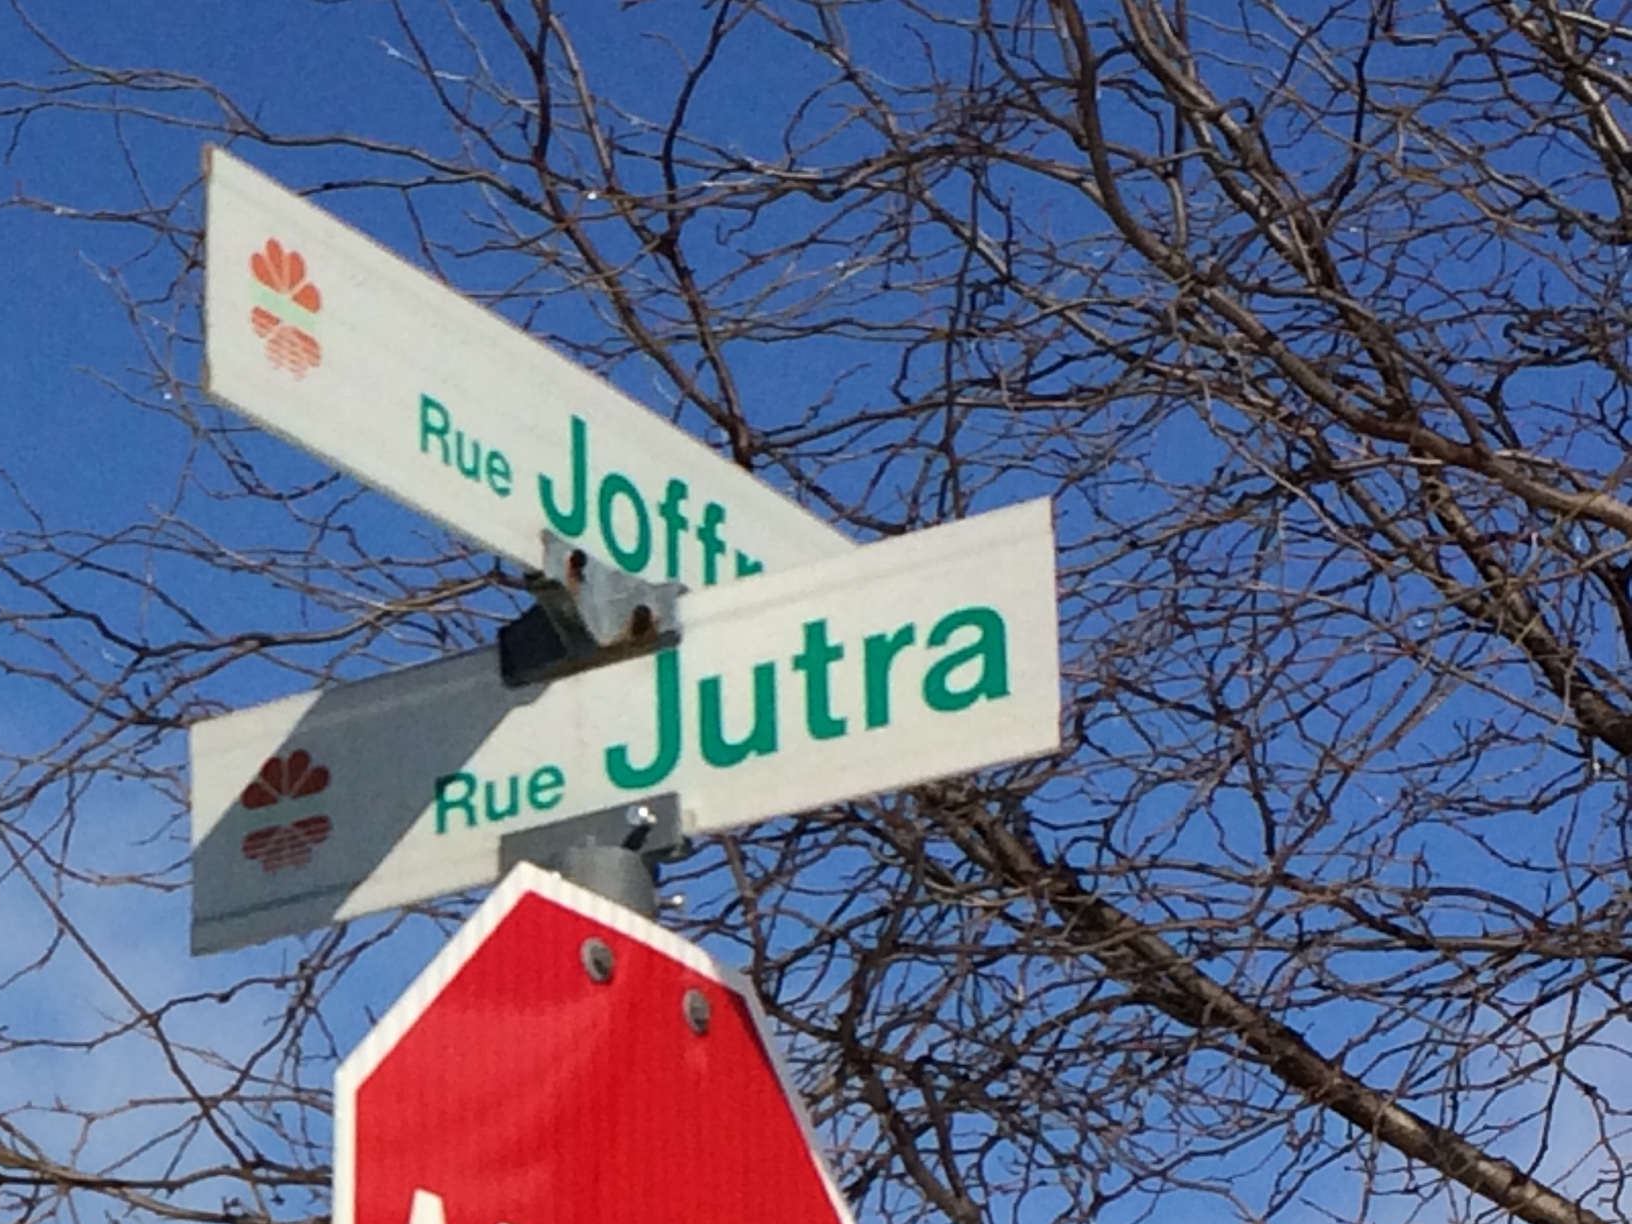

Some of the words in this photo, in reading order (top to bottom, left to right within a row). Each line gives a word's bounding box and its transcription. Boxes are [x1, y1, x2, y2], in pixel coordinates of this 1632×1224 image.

[419, 393, 513, 498] Rue
[434, 765, 566, 835] Rue
[605, 604, 1011, 791] Jutra
